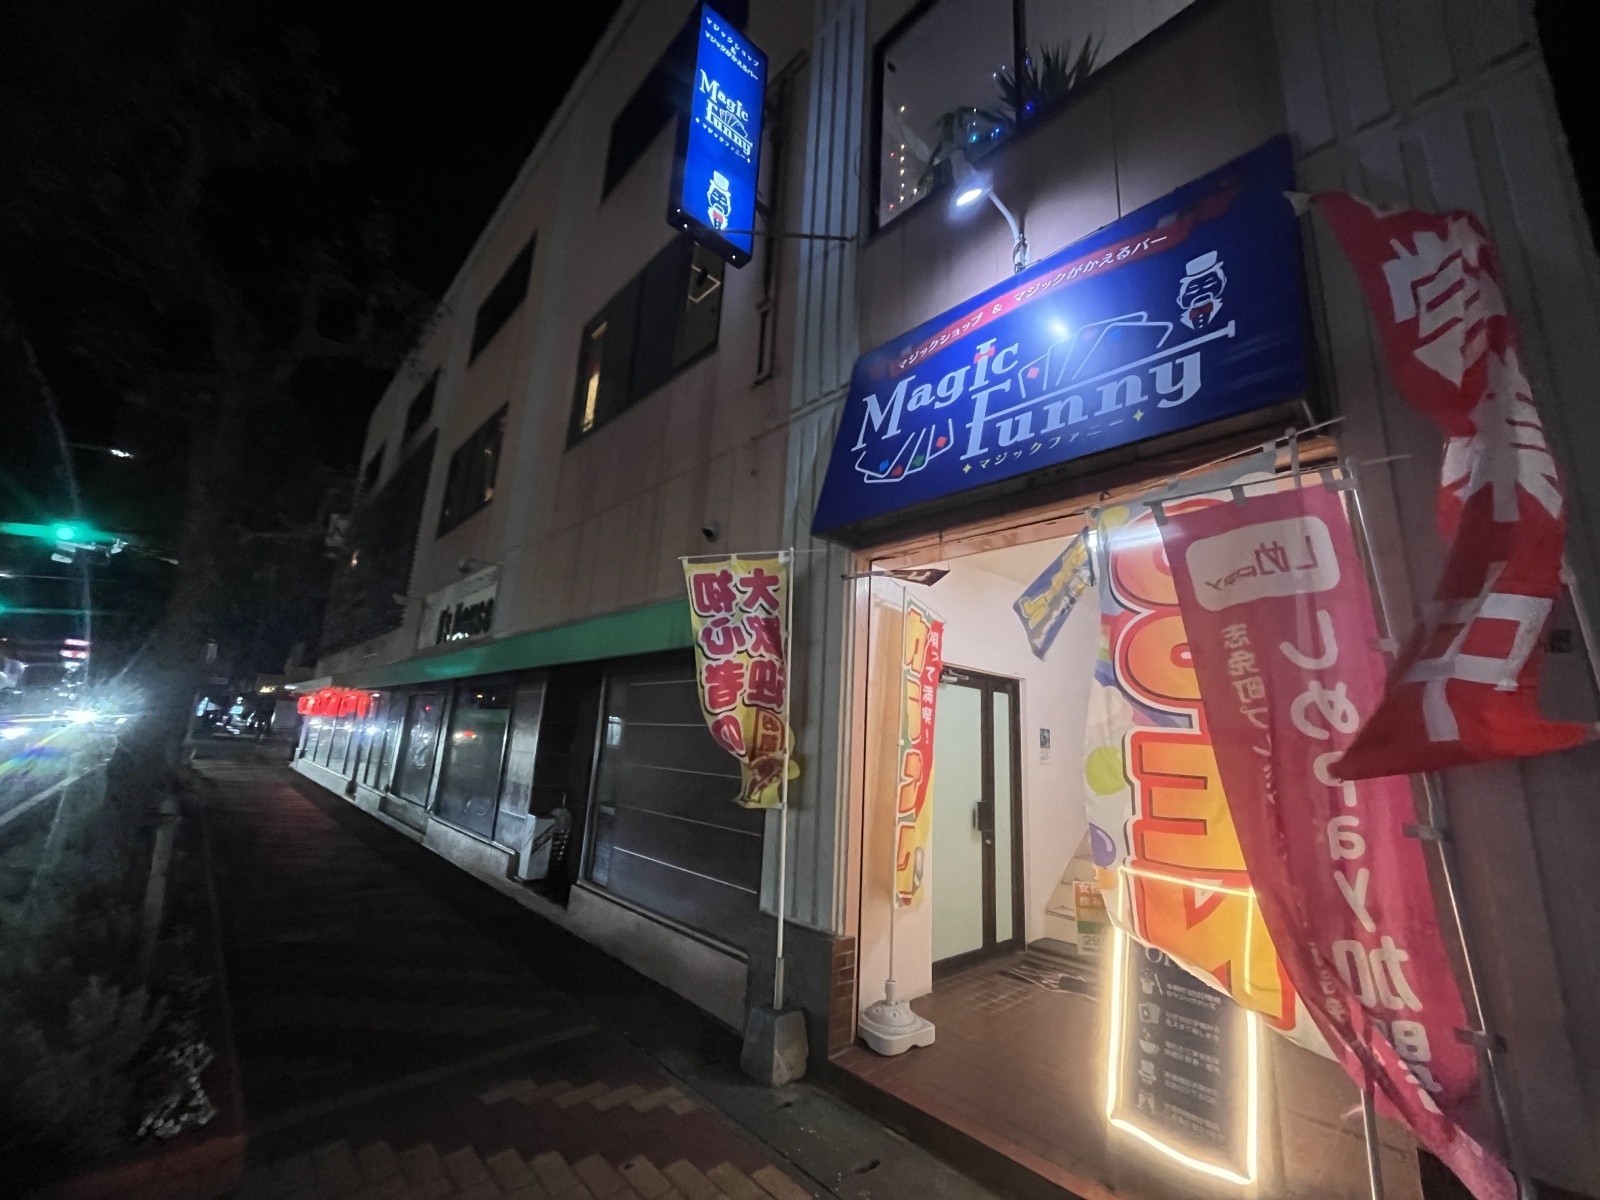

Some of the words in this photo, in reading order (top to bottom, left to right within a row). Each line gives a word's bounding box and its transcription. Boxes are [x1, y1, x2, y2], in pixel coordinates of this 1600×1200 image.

[706, 16, 760, 67] マジックショップ
[699, 68, 749, 122] Magic
[702, 122, 746, 159] マジックファニー
[705, 98, 754, 156] Funny
[899, 312, 984, 369] マジックショップ
[992, 303, 1003, 316] &
[1013, 236, 1168, 303] マジックがかえるバー
[851, 337, 1019, 452] Magic
[960, 328, 1226, 461] Funny
[979, 419, 1124, 469] マジックファニー
